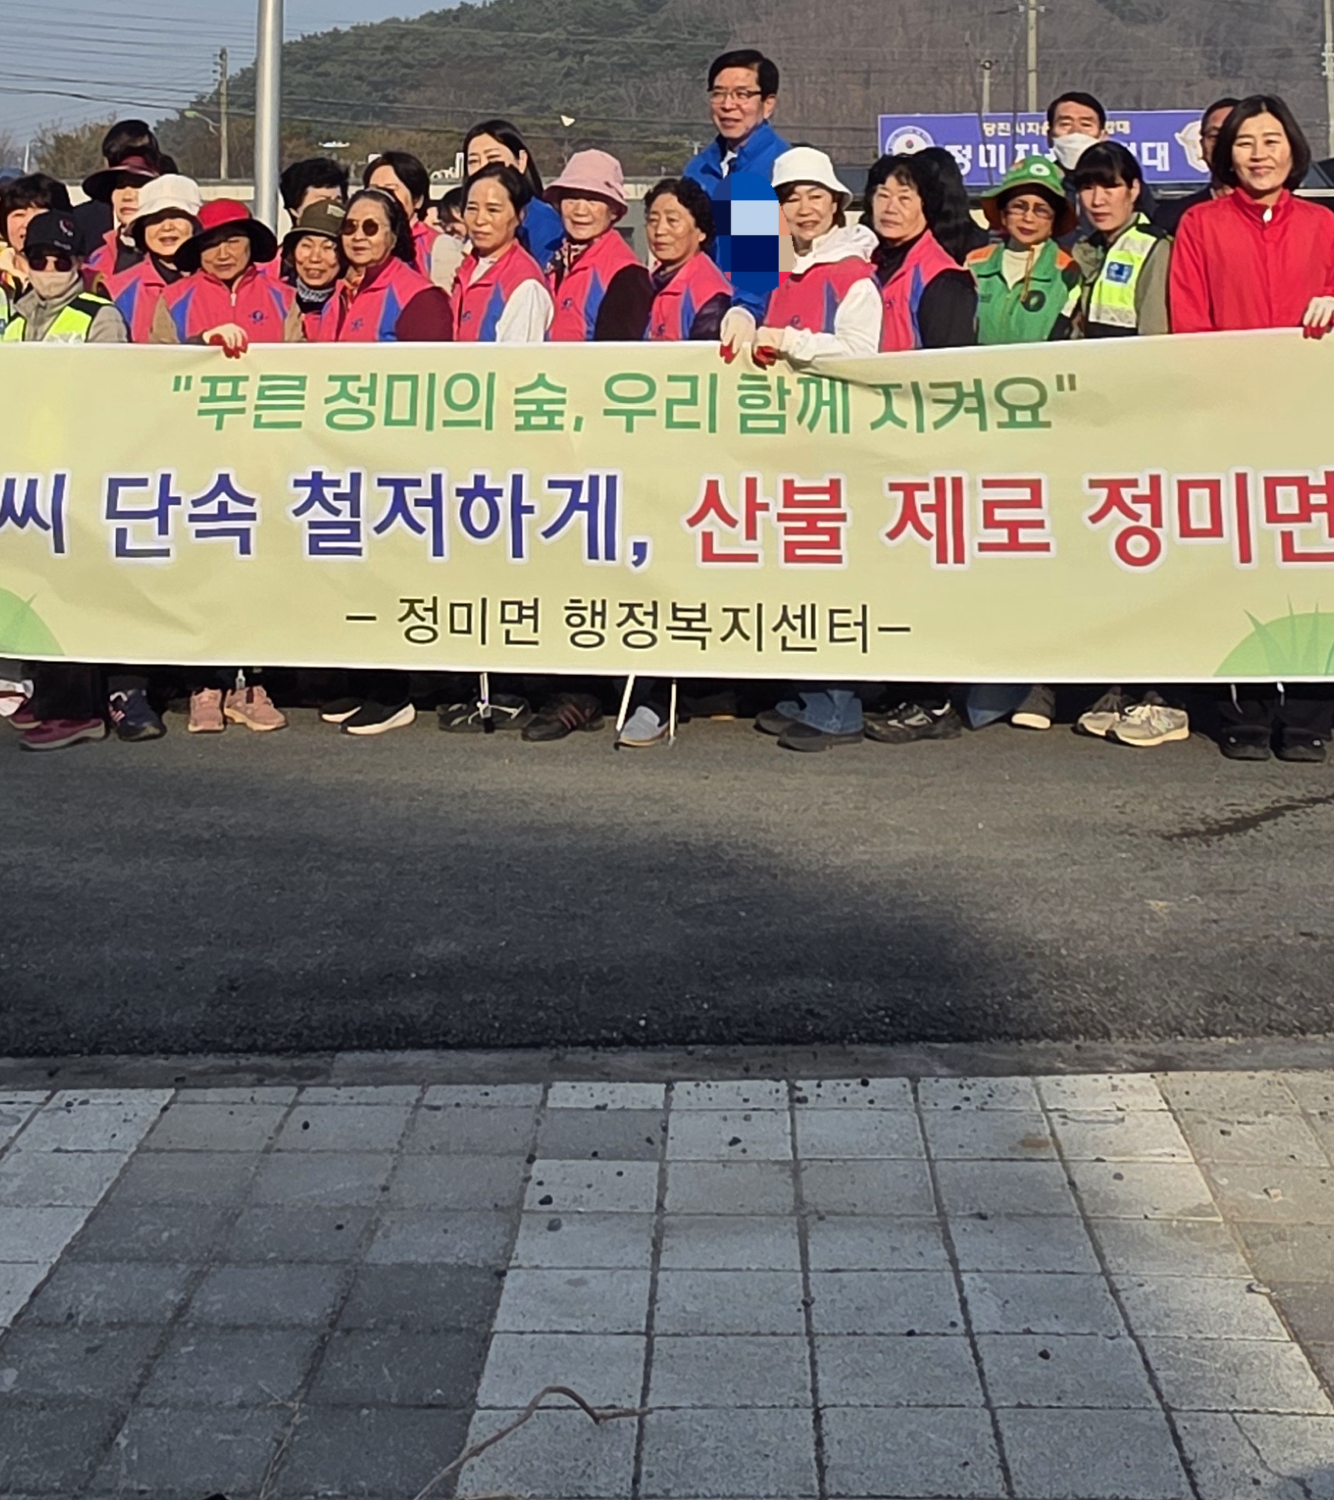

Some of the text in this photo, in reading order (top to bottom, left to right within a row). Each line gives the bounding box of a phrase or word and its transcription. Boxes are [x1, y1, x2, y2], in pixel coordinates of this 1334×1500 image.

[173, 372, 1078, 435] "푸른 정미의 숲, 우리 함께 지켜요"
[104, 473, 258, 557] 단속
[291, 470, 648, 567] 철저하게,
[685, 476, 848, 564] 산불
[886, 476, 1052, 565] 제로
[397, 596, 541, 646] 정미면
